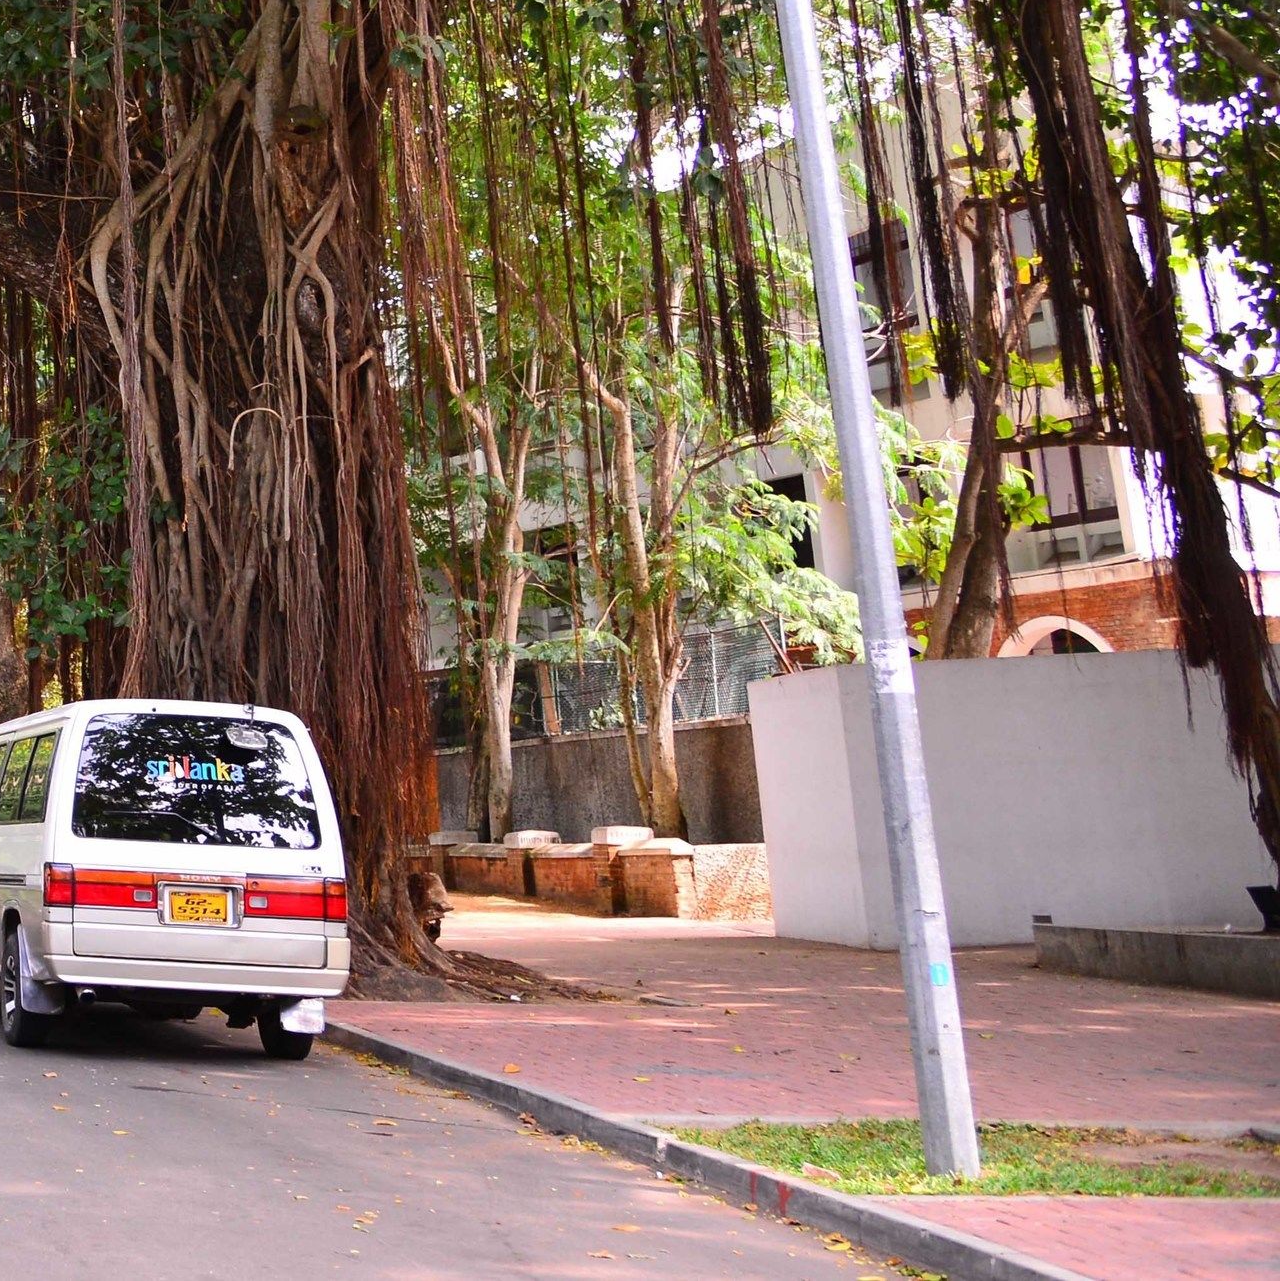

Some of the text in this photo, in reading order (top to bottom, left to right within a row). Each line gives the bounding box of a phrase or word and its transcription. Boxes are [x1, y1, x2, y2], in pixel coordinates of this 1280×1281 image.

[182, 755, 245, 783] lanka
[201, 783, 214, 791] OF
[180, 874, 222, 883] HOMY
[176, 906, 221, 915] 5514
